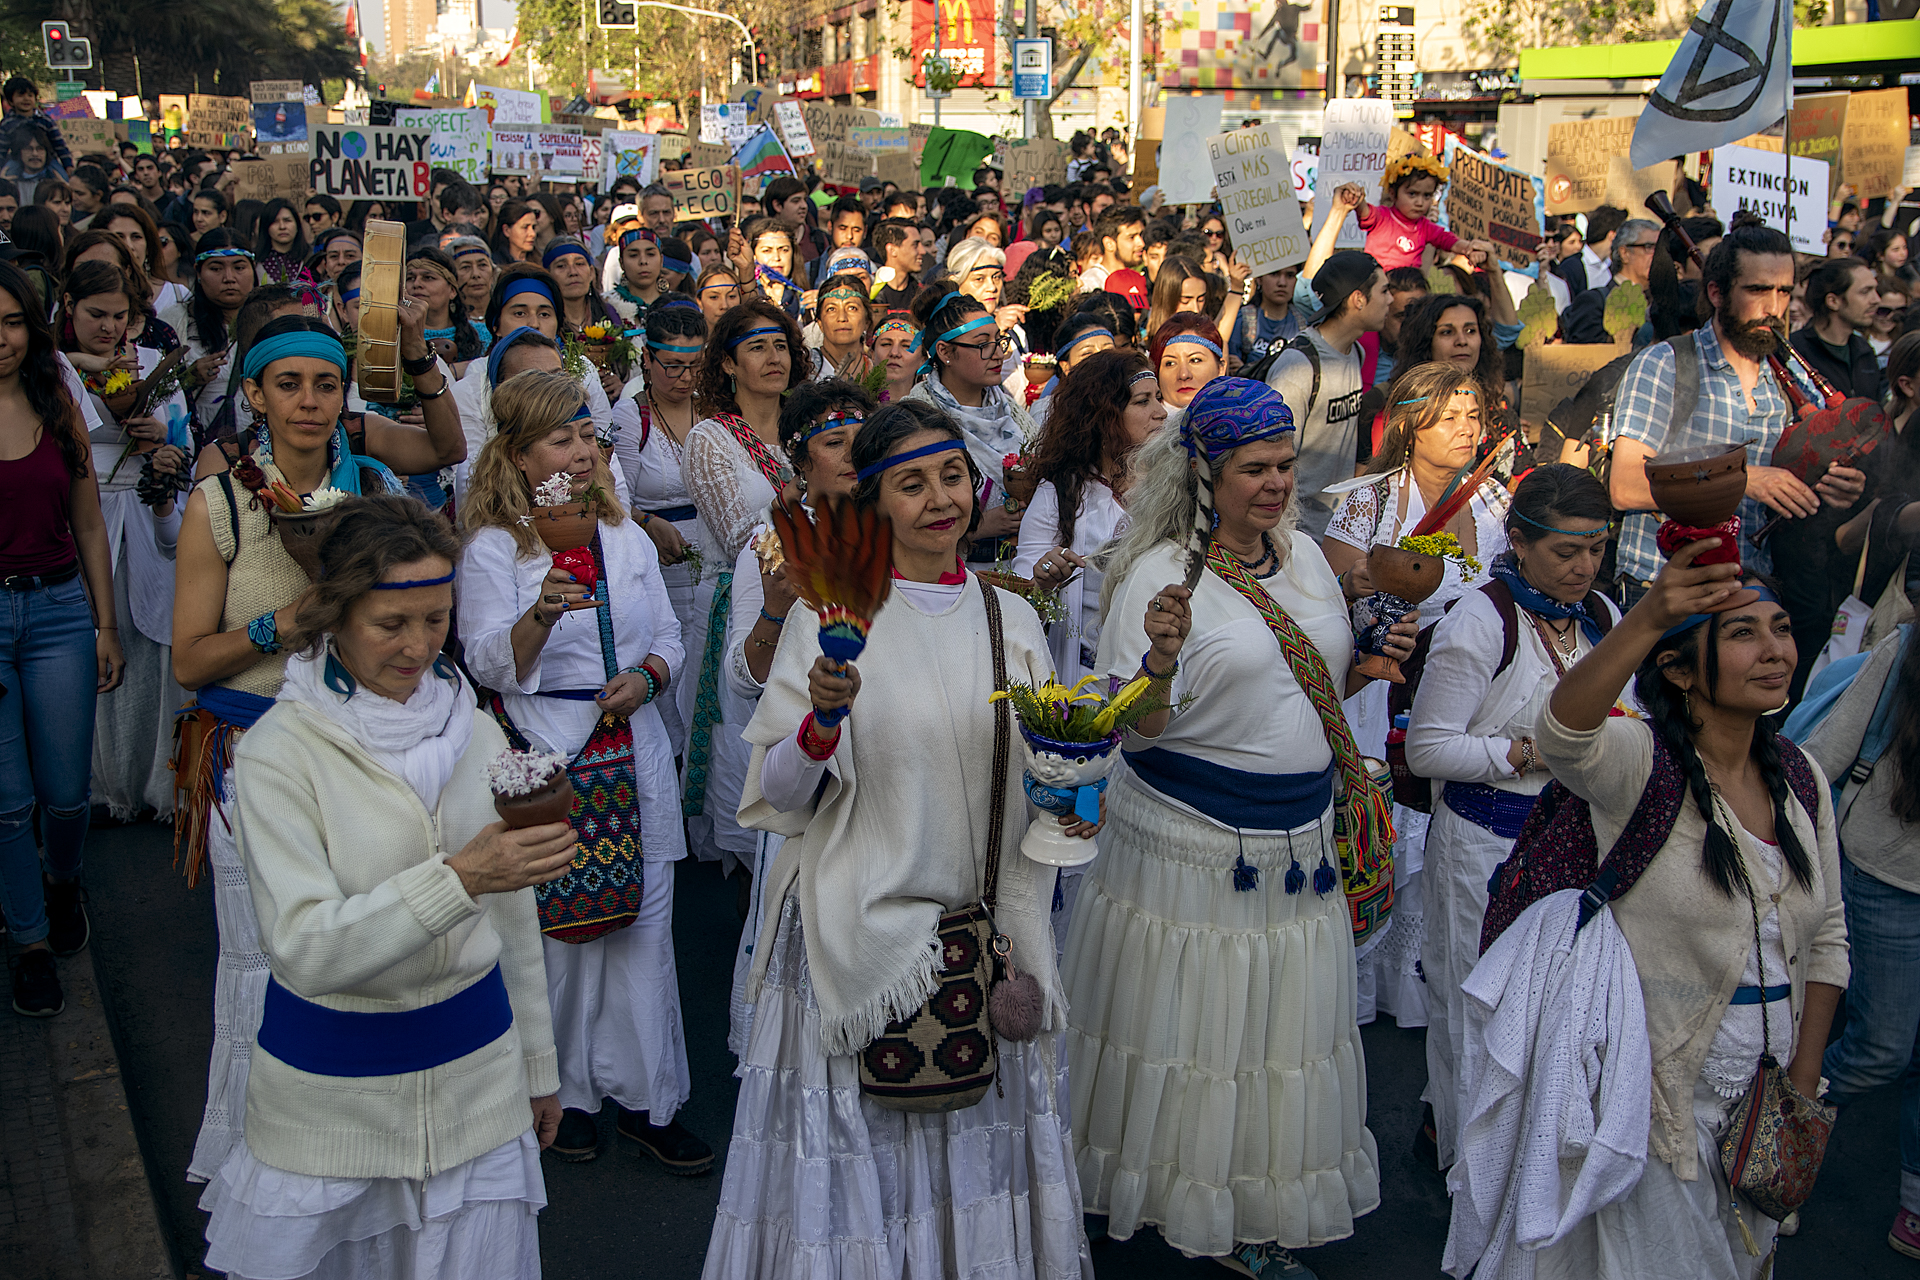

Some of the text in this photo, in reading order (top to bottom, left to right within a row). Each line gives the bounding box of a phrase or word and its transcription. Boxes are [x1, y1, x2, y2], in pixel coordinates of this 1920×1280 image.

[1329, 103, 1391, 125] EL MUNDO
[375, 132, 431, 162] HAY
[1224, 131, 1272, 156] Clima
[1322, 131, 1364, 150] CAMBIA
[1241, 155, 1270, 181] MÁS
[1323, 152, 1387, 172] TU EJEMPLO
[309, 158, 430, 197] PLANETA B
[1728, 166, 1809, 197] EXTINCIÓN
[1221, 180, 1292, 216] IRREGULAR
[1738, 196, 1798, 222] MASIVA
[1235, 218, 1254, 234] Que
[1237, 235, 1301, 266] PERIODO
